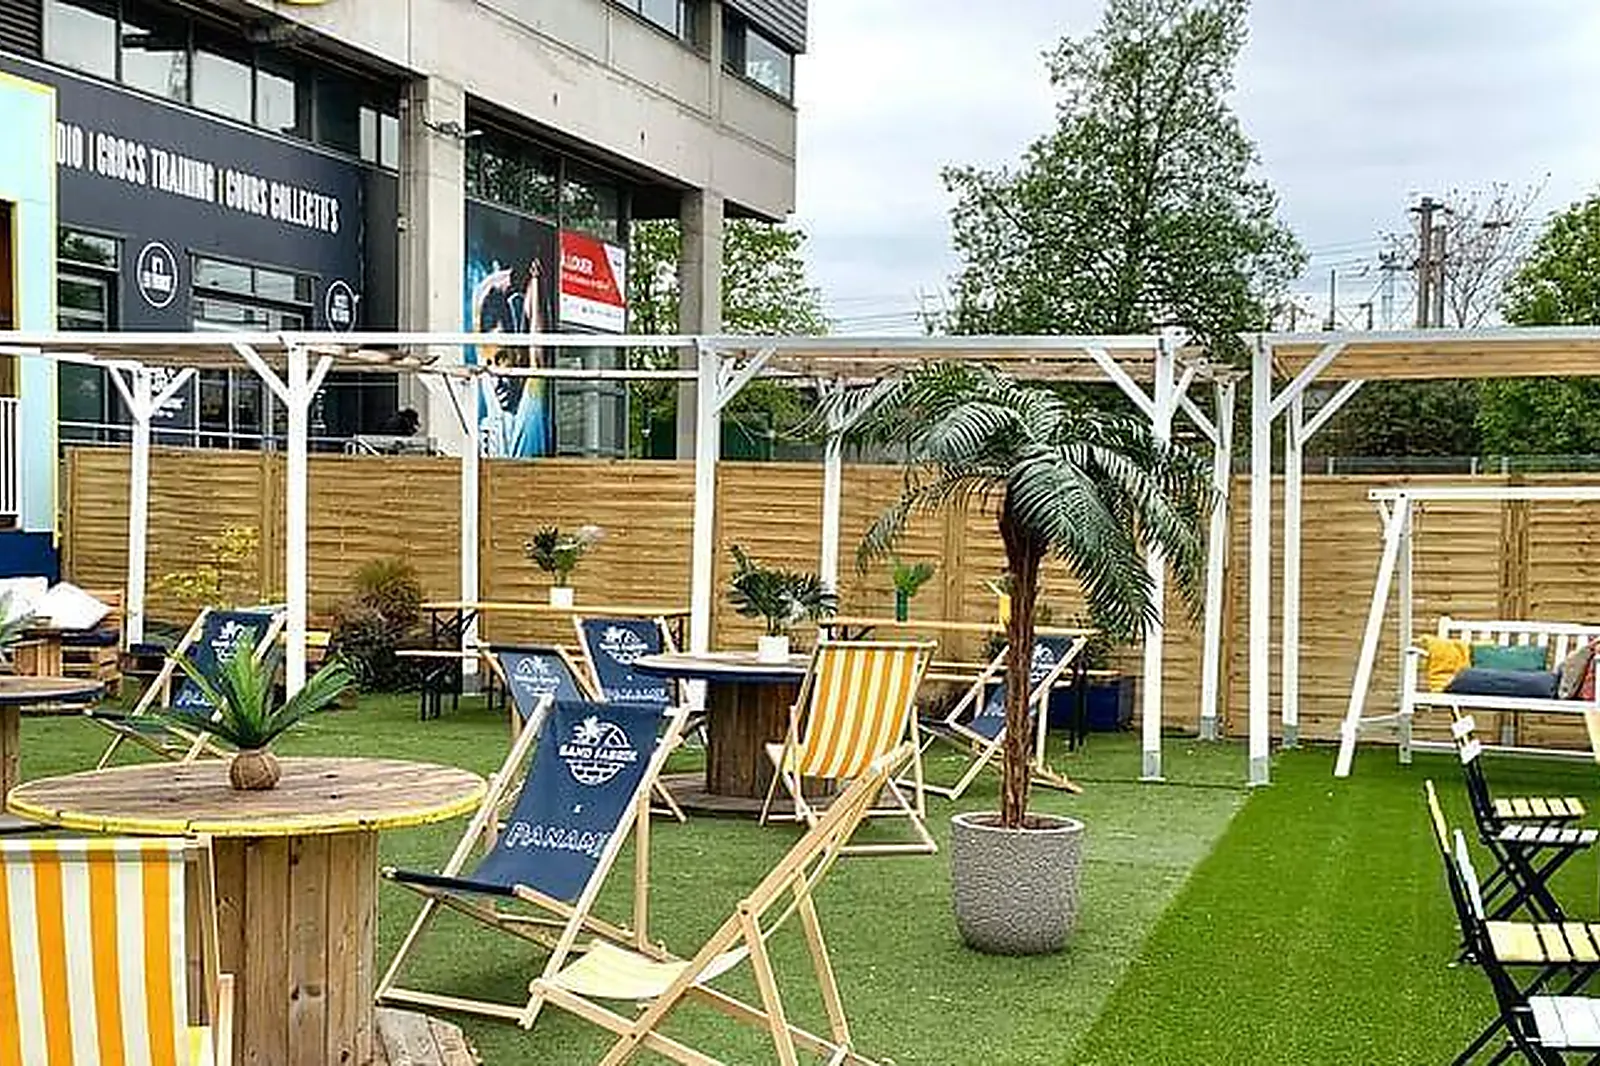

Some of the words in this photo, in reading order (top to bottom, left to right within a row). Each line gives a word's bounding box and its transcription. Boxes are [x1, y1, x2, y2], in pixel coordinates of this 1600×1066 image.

[97, 133, 146, 185] CROSS
[150, 148, 214, 202] TRAINING
[226, 170, 267, 216] COURS
[271, 182, 339, 234] COLLECTIFS
